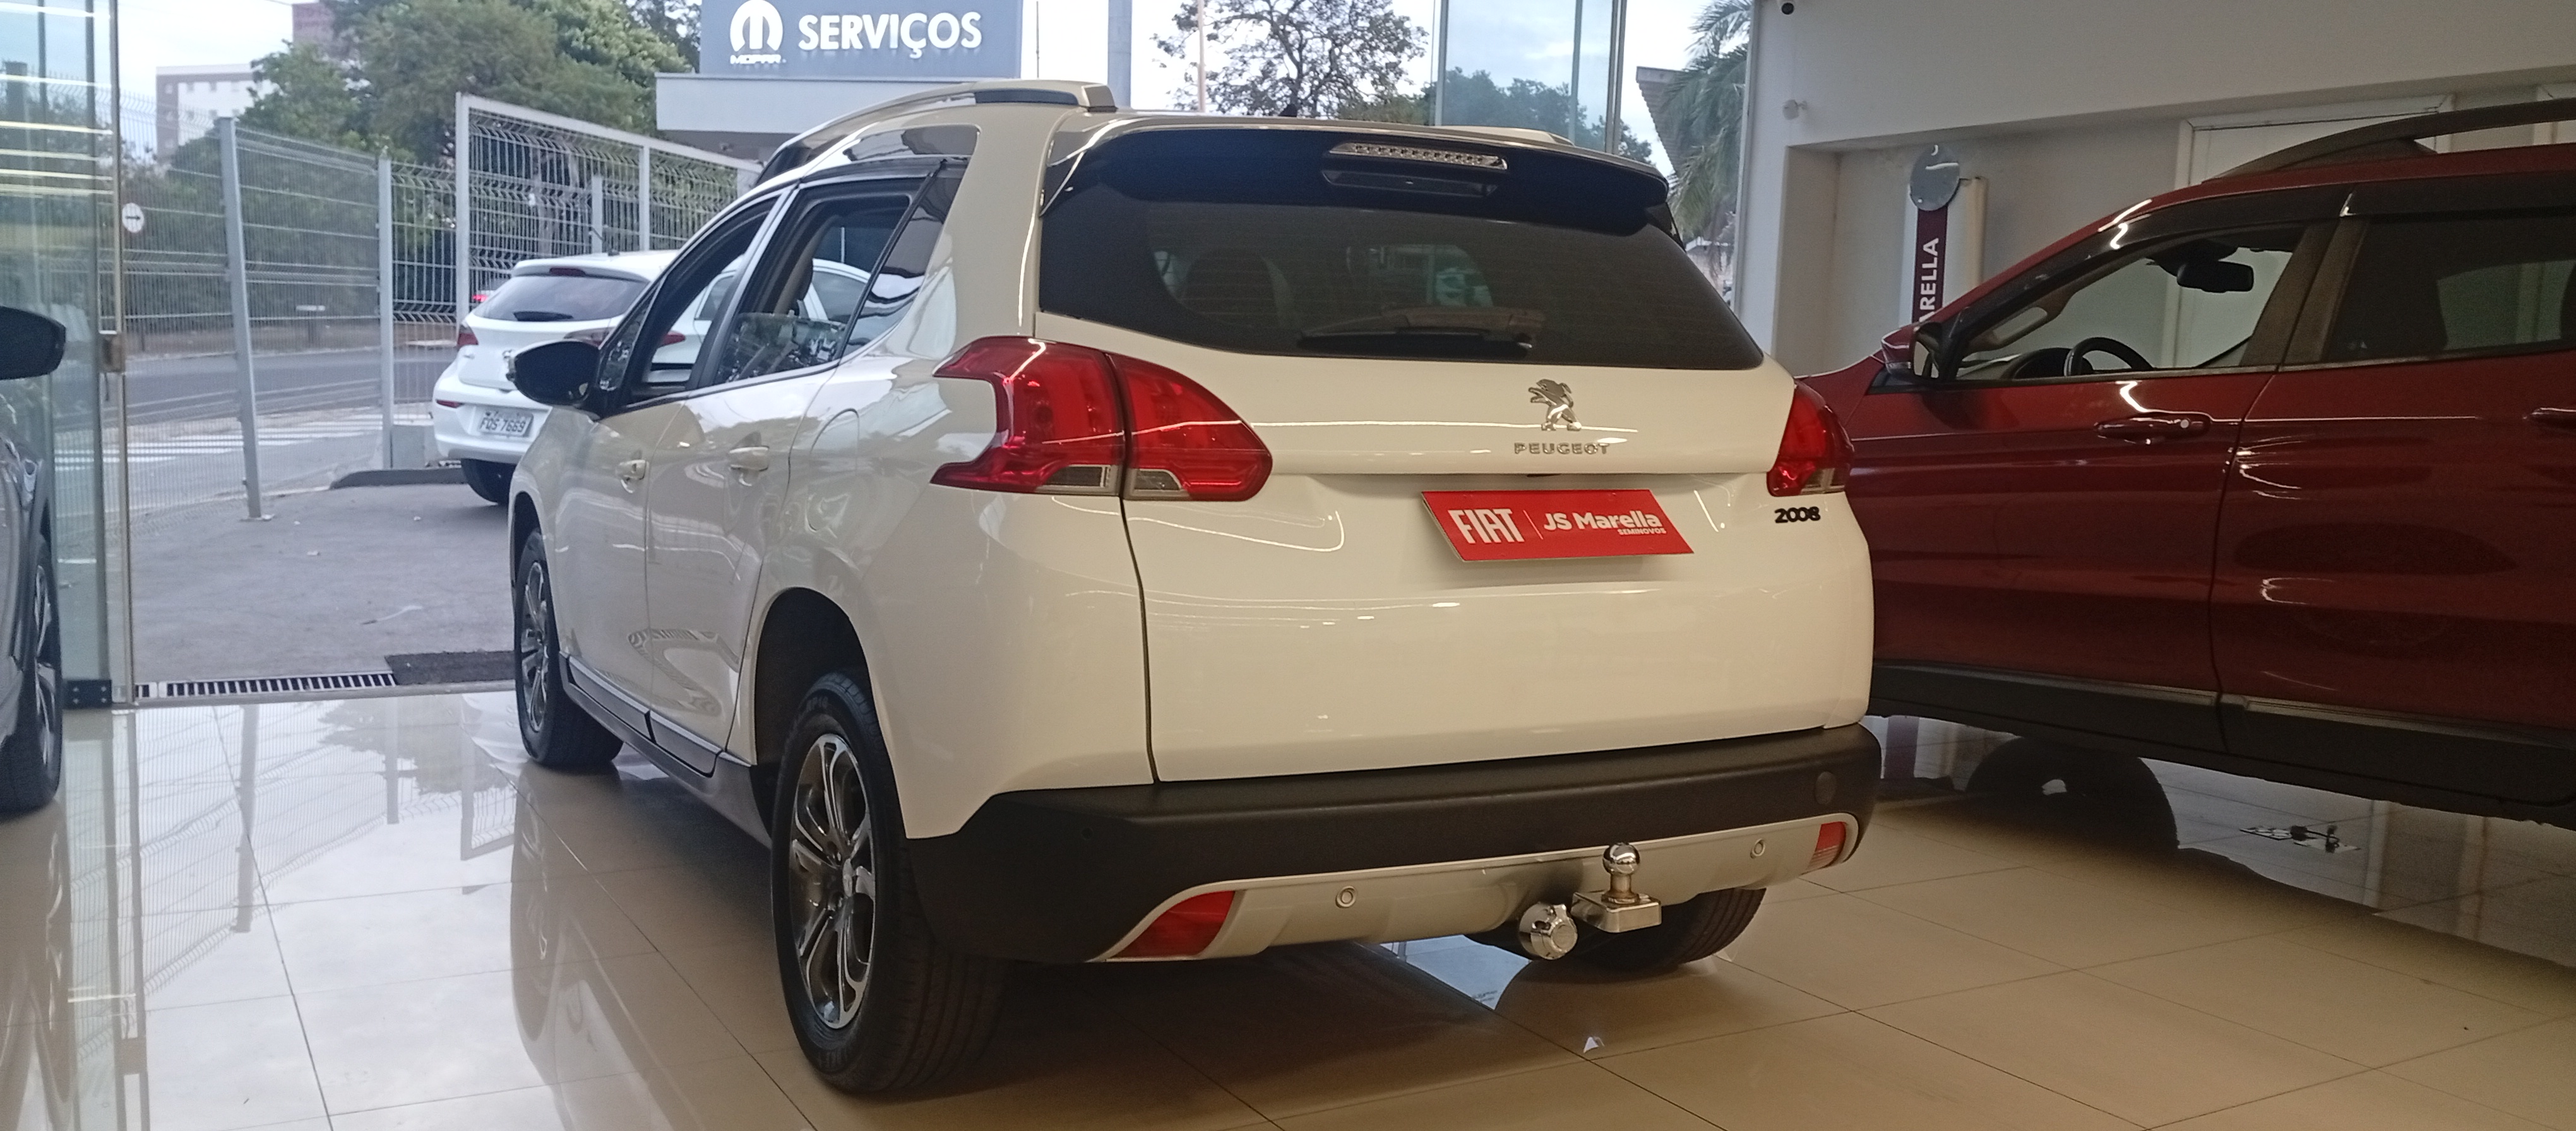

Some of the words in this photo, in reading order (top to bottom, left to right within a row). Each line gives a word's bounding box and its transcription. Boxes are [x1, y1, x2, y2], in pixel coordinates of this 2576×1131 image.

[798, 12, 982, 59] SERVIÇOS
[1514, 442, 1610, 454] PEUGEOT
[1448, 509, 1525, 544] FIAT
[1544, 513, 1572, 531] JS
[1572, 511, 1663, 530] Marella
[1774, 506, 1821, 523] 2008
